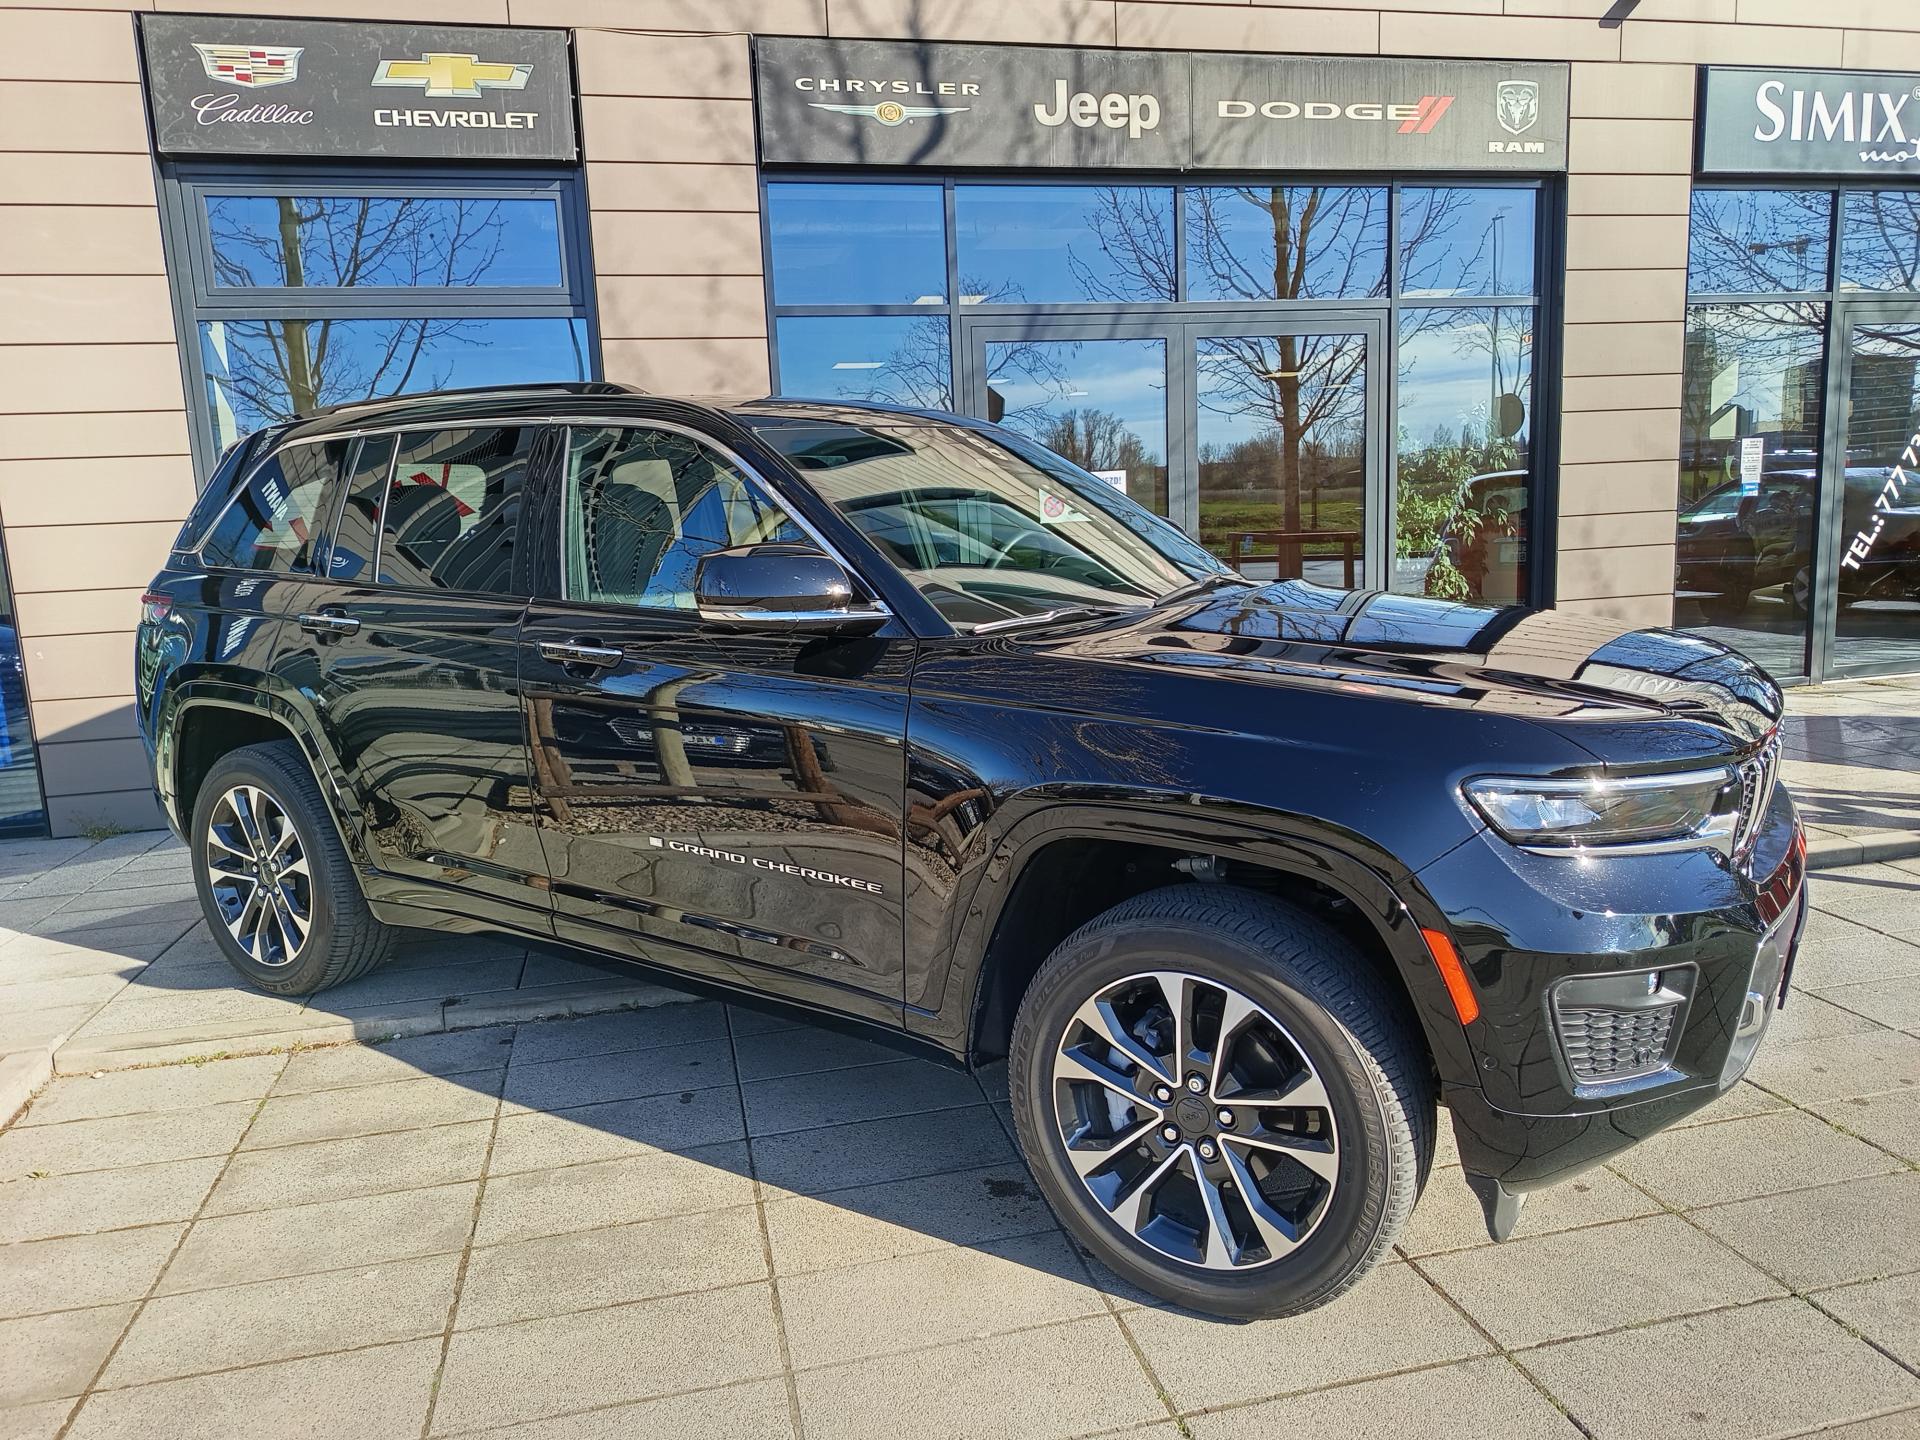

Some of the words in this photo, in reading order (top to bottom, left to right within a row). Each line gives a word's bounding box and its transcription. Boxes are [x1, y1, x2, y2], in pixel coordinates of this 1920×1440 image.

[795, 77, 981, 96] CHRYSLER
[191, 93, 314, 127] Cadillac
[373, 109, 539, 129] CHEVROLET
[1033, 79, 1161, 138] Jeep
[1218, 100, 1421, 120] DODGE
[1754, 80, 1910, 143] SIMIX
[1488, 141, 1545, 153] RAM
[668, 840, 746, 864] GRAND
[752, 857, 883, 894] CHEROKEE
[1346, 1070, 1385, 1246] BRIDGESTONE
